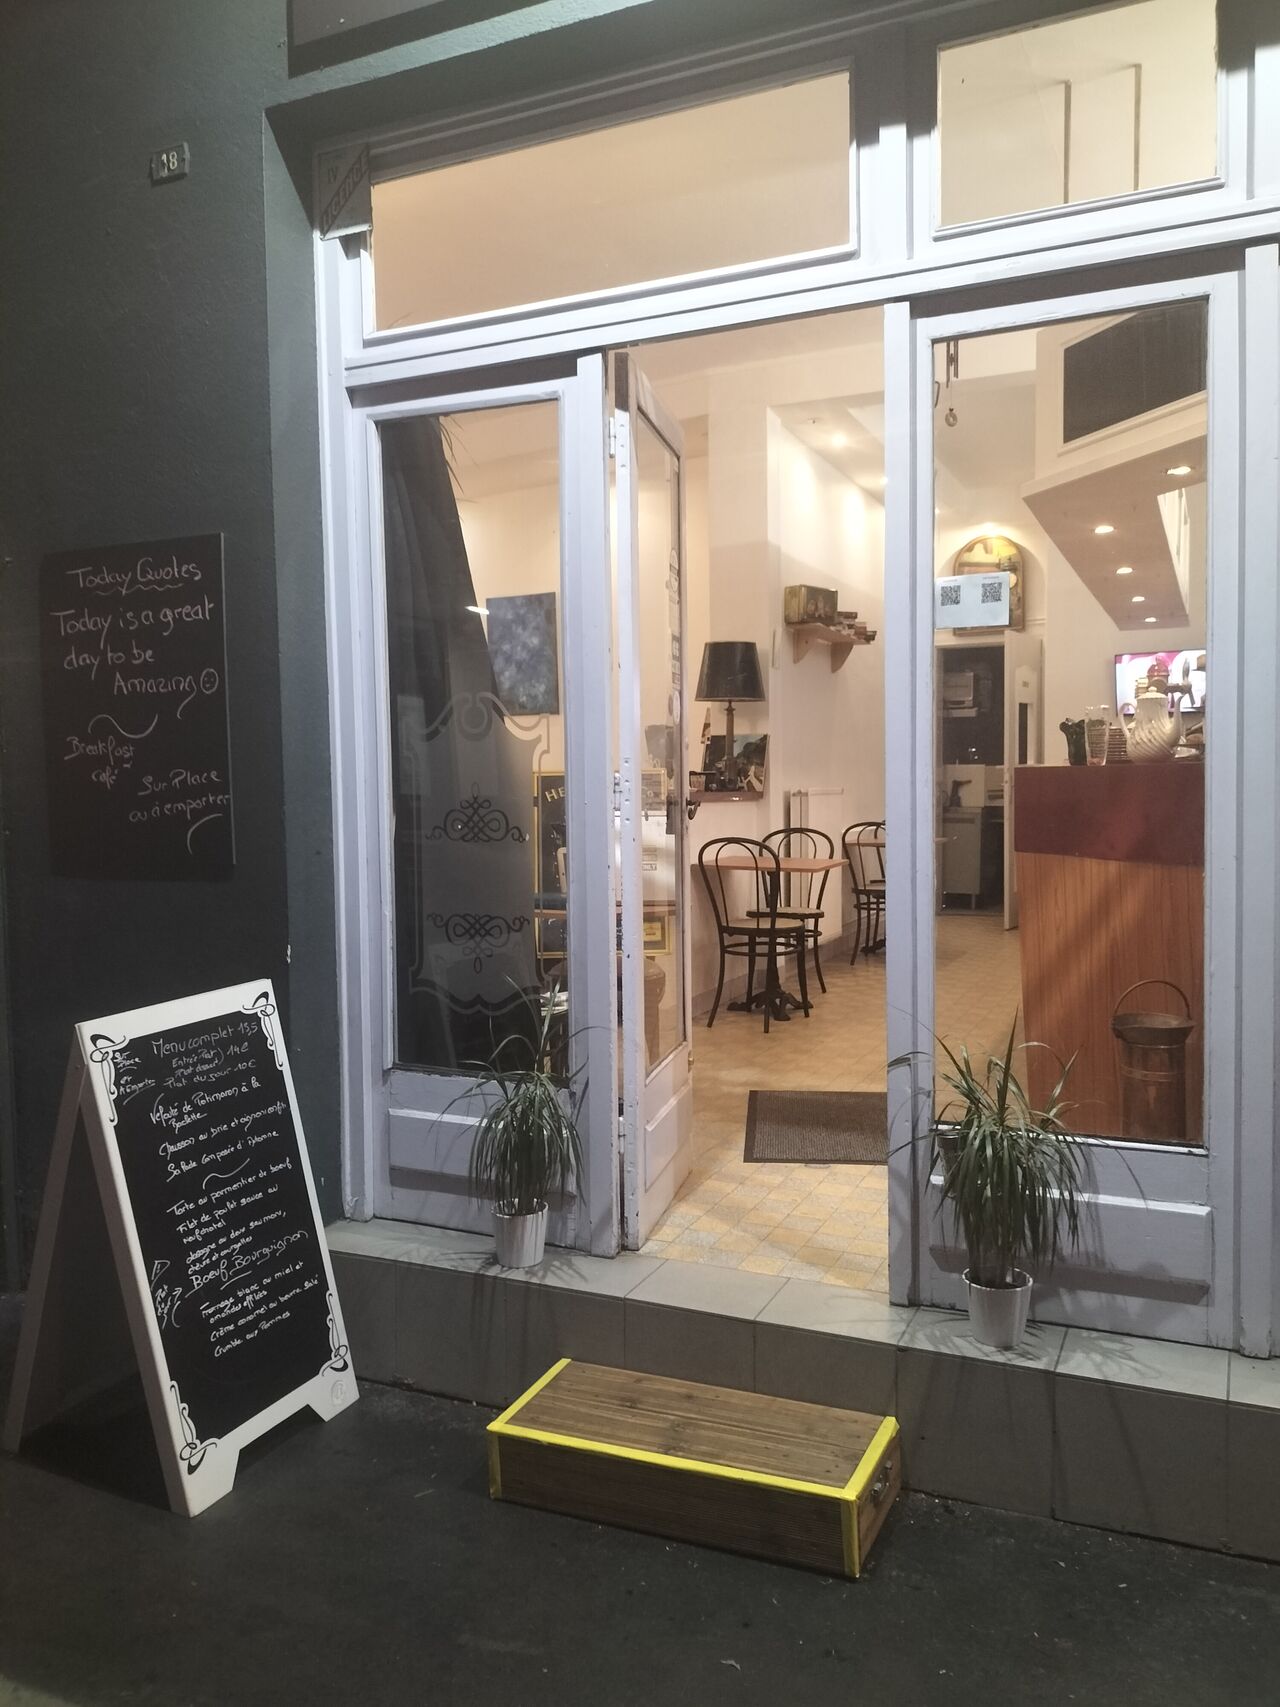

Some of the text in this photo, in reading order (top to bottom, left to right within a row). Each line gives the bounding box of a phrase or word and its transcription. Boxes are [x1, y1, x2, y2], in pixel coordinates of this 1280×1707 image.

[161, 151, 178, 177] 18
[65, 556, 201, 596] Today Quotes
[50, 594, 214, 649] Today is a great
[64, 640, 155, 680] day to be
[114, 671, 197, 719] Amazing
[64, 736, 134, 766] Breakfast
[138, 769, 222, 795] Sur Place
[152, 1038, 185, 1058] Menu
[188, 1025, 234, 1046] complet
[163, 1077, 187, 1088] Plat
[193, 1075, 206, 1083] du
[183, 1101, 193, 1113] de
[167, 1200, 195, 1215] Tarte
[229, 1230, 309, 1276] Bourguignon
[275, 1264, 293, 1279] miel
